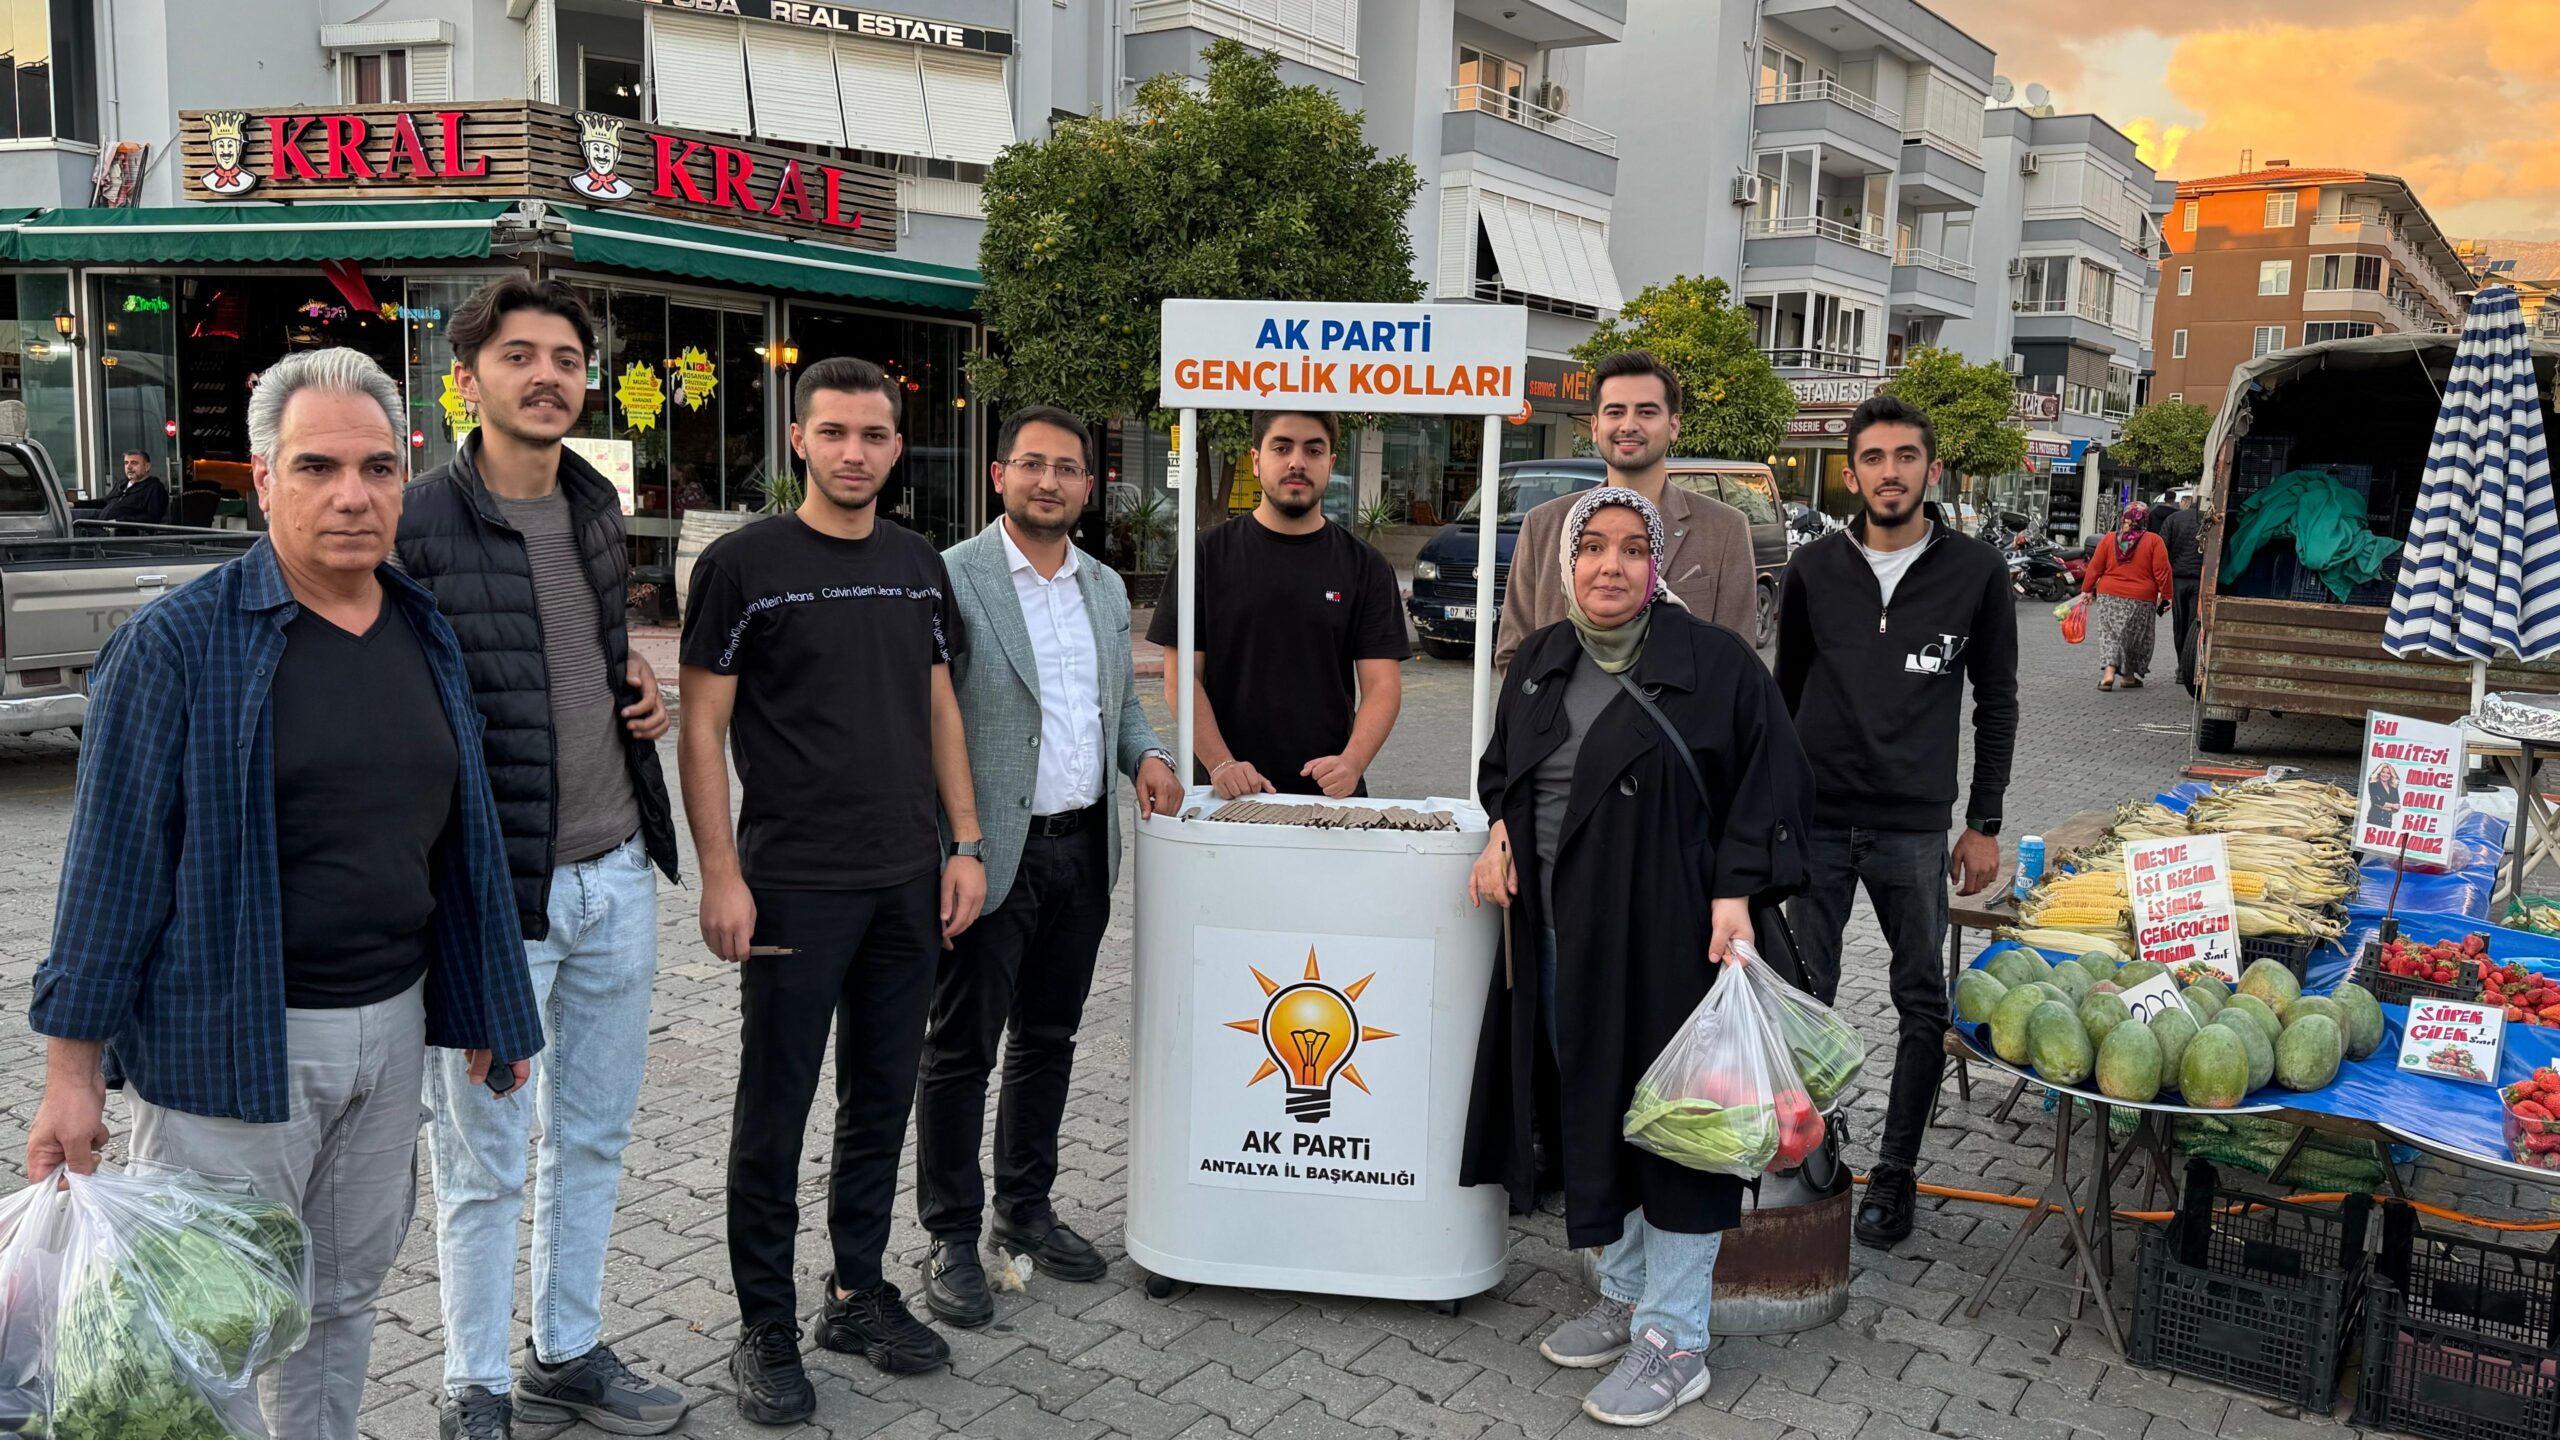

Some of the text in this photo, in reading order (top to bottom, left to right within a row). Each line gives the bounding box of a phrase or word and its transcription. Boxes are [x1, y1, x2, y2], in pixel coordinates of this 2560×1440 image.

[770, 1, 849, 30] REAL
[857, 13, 964, 47] ESTATE
[263, 112, 488, 180] KRAL
[649, 134, 862, 230] KRAL
[1255, 314, 1431, 353] AK PARTİ
[1174, 355, 1512, 398] GENÇLİK KOLLARI
[1529, 380, 1557, 398] SERVICE
[1793, 376, 1867, 404] STANESİ
[1786, 421, 1820, 432] TISSERIE
[759, 595, 783, 609] Klein
[784, 591, 815, 602] Jeans
[821, 586, 852, 599] Calvin
[852, 585, 876, 597] Klein
[877, 585, 902, 596] Jeans
[2363, 826, 2444, 855] BULAMAZ
[2133, 844, 2188, 872] MEYVE
[1242, 1130, 1282, 1154] AK
[1200, 1159, 1416, 1186] ANTALYA İL BAŞKANLIĞI
